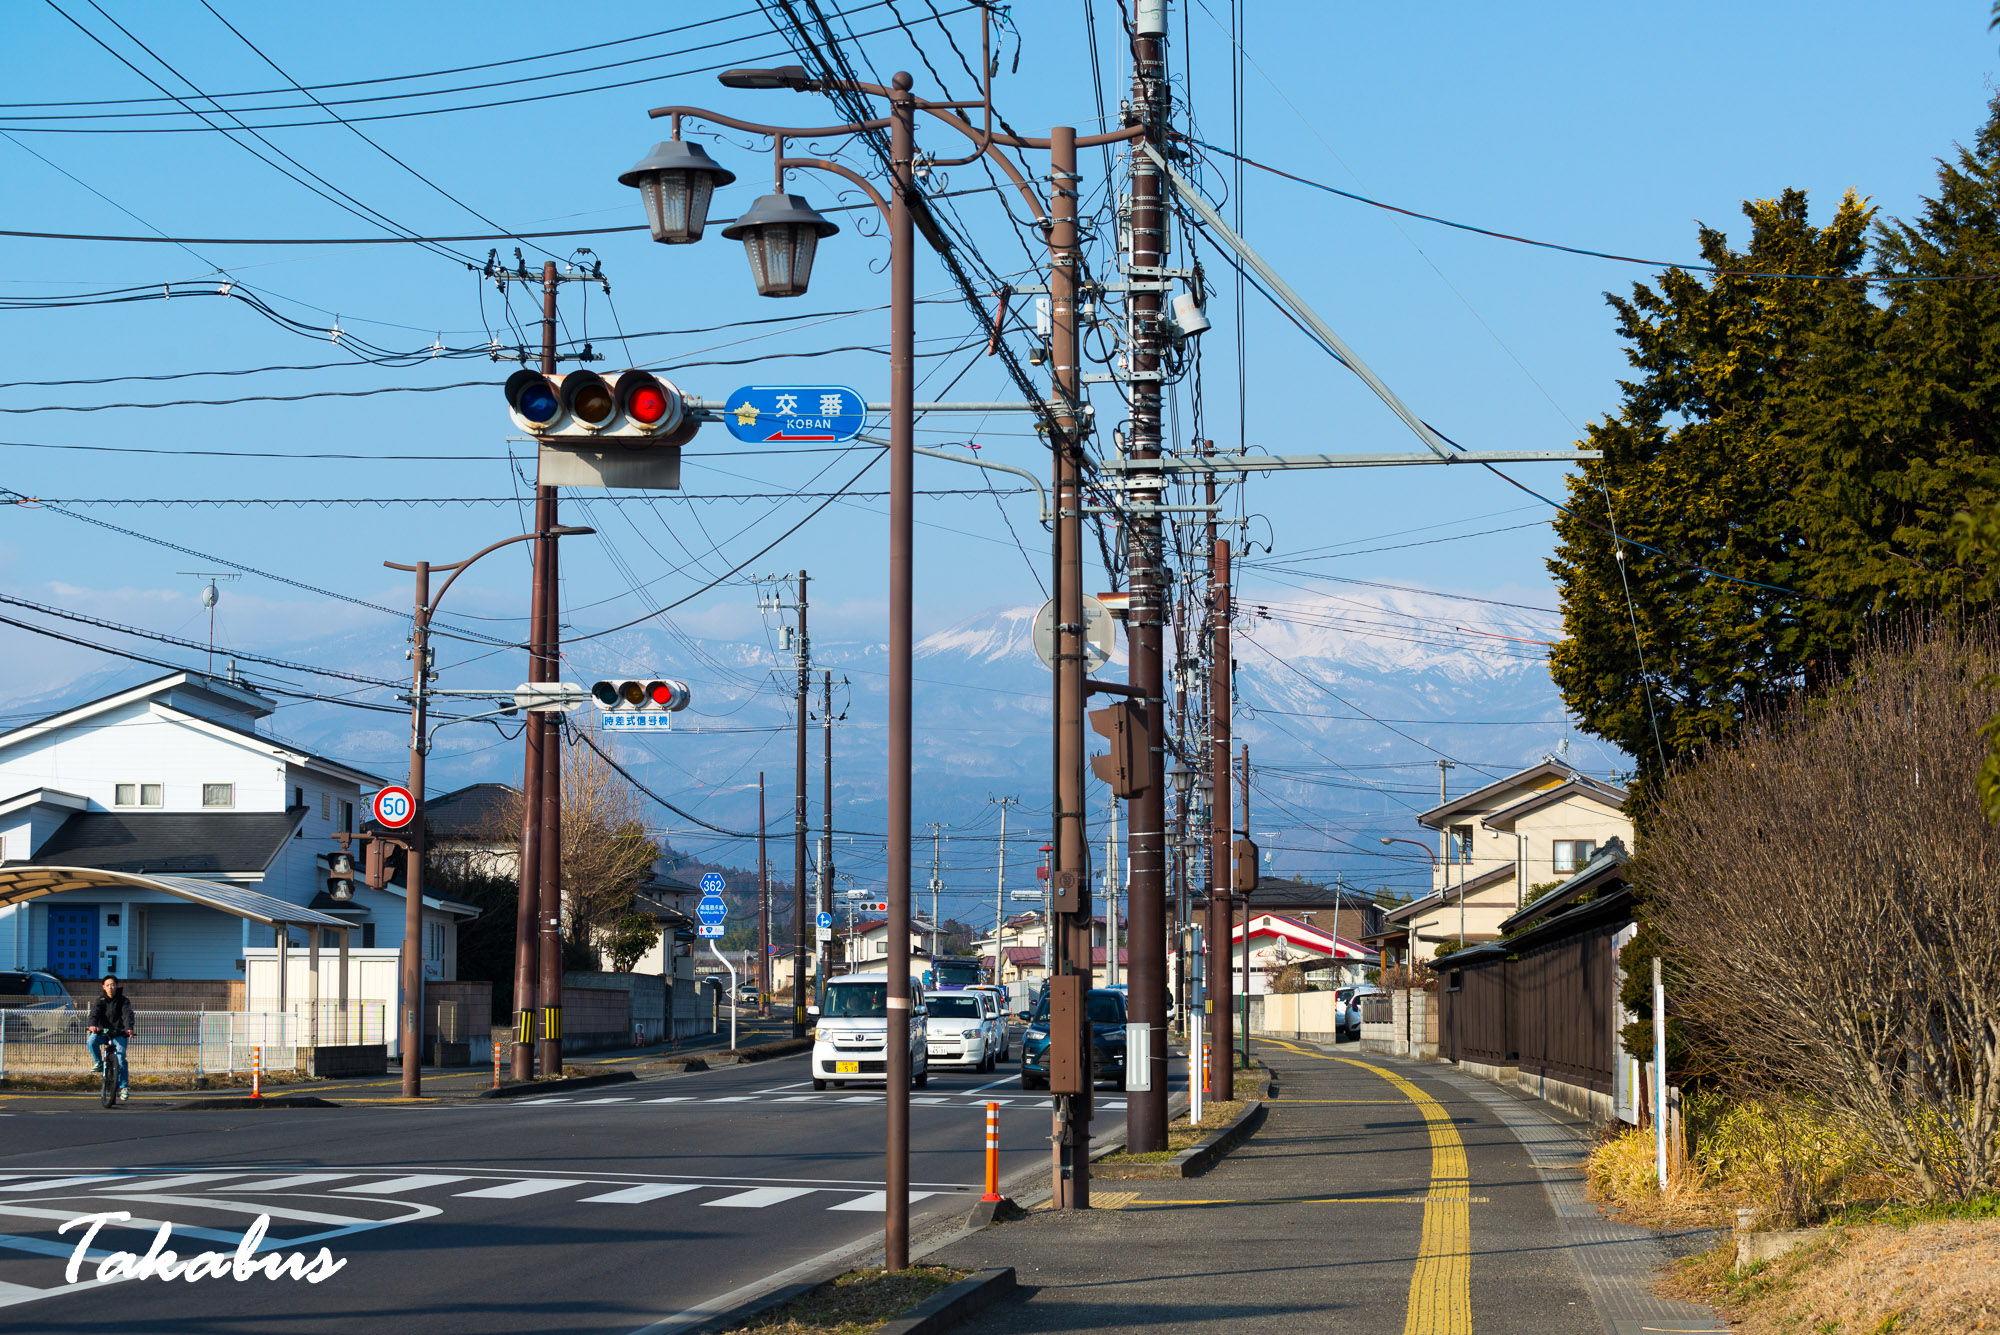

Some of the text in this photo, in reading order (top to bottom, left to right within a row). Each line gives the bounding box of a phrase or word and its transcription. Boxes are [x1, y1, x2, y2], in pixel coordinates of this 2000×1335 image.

[775, 393, 843, 418] 交番
[786, 419, 832, 430] KOBAN
[604, 715, 668, 726] 時差式信号機
[383, 797, 406, 816] 50
[703, 880, 722, 892] 362
